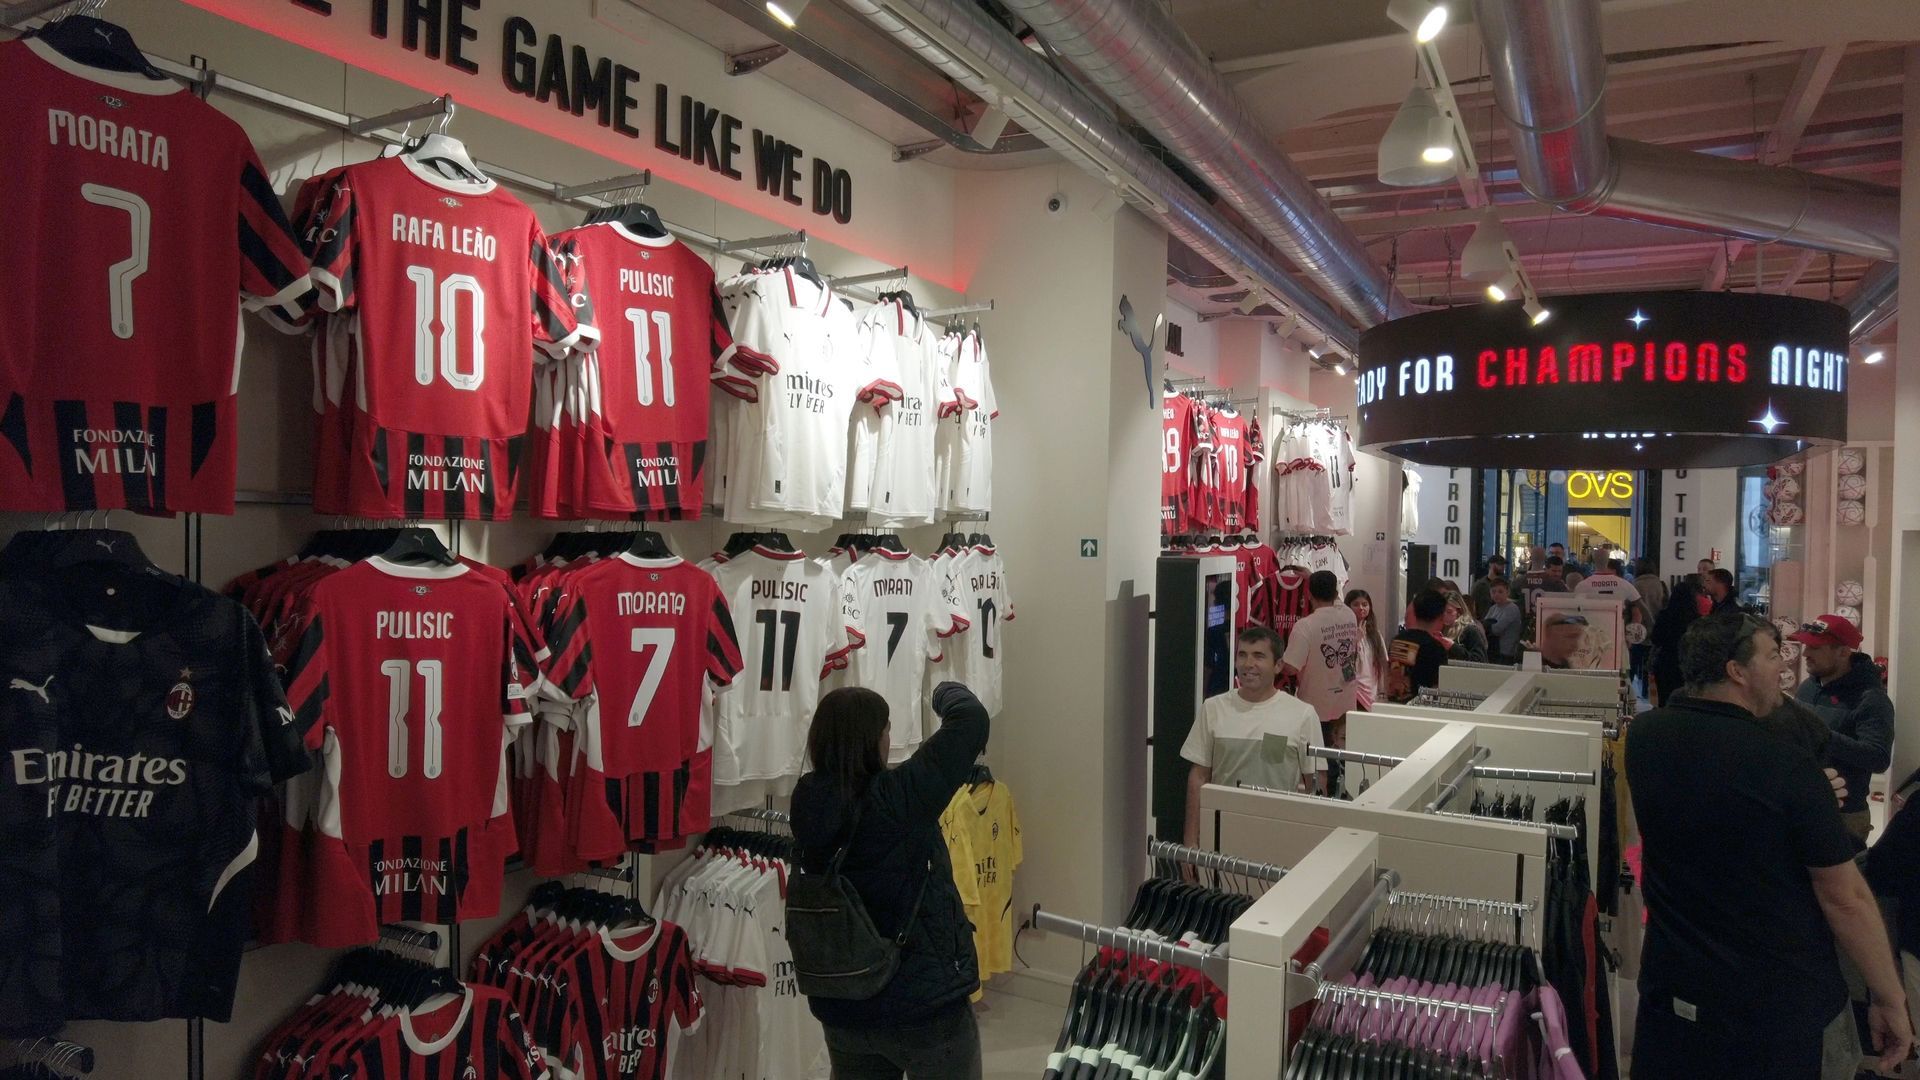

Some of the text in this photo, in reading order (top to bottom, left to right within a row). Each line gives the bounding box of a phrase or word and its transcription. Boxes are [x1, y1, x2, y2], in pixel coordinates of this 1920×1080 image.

[48, 108, 169, 171] MORATA
[501, 16, 641, 139] GAME
[654, 83, 743, 182] LIKE
[752, 128, 803, 206] WE
[812, 157, 852, 224] DO
[80, 182, 151, 339] 7
[392, 213, 496, 262] RAFA LEÃO
[619, 268, 675, 299] PULISIC
[406, 265, 485, 391] 10
[625, 307, 675, 407] 11
[1398, 354, 1454, 397] FOR
[1476, 341, 1748, 389] CHAMPIONS
[1770, 345, 1845, 393] NIGHT
[408, 469, 485, 494] MILAN
[409, 454, 485, 470] FONDAZIONE
[1567, 471, 1633, 499] OVS
[1674, 492, 1687, 560] THE
[617, 591, 686, 616] MORATA
[751, 579, 808, 602] PULISIC
[376, 611, 454, 640] PULISIC
[755, 609, 801, 691] 11
[627, 627, 675, 727] 7
[380, 659, 442, 779] 11
[64, 785, 153, 818] BETTER
